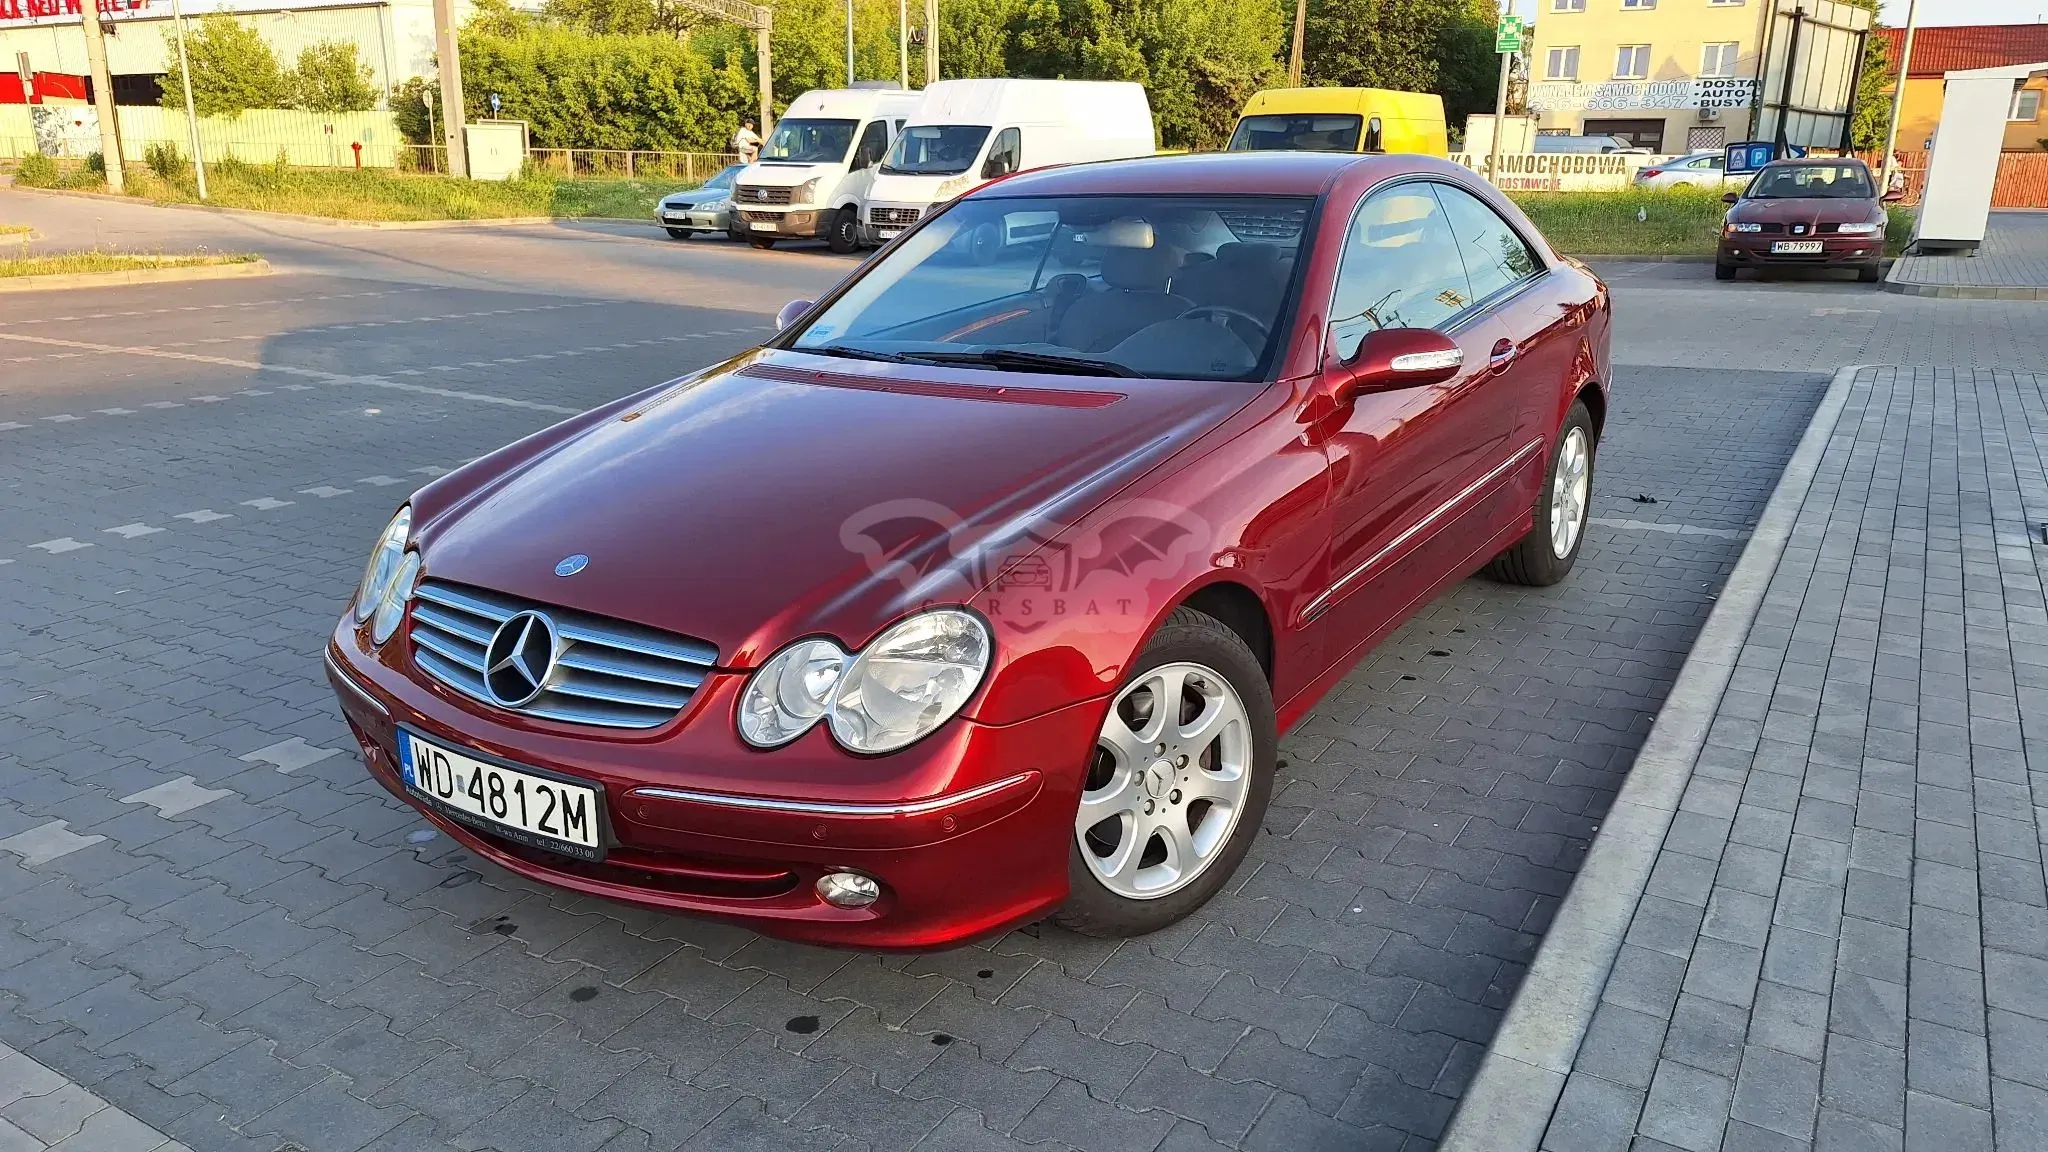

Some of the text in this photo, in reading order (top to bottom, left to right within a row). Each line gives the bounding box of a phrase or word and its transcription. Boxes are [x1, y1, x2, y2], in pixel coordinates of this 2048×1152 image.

[1530, 80, 1690, 98] WYNAJEM SAMOCHODÓW
[1527, 96, 1688, 110] 666-666-347
[1700, 99, 1744, 107] BUSY
[1484, 154, 1626, 174] SAMOCHODOWA
[468, 766, 588, 842] 4812M
